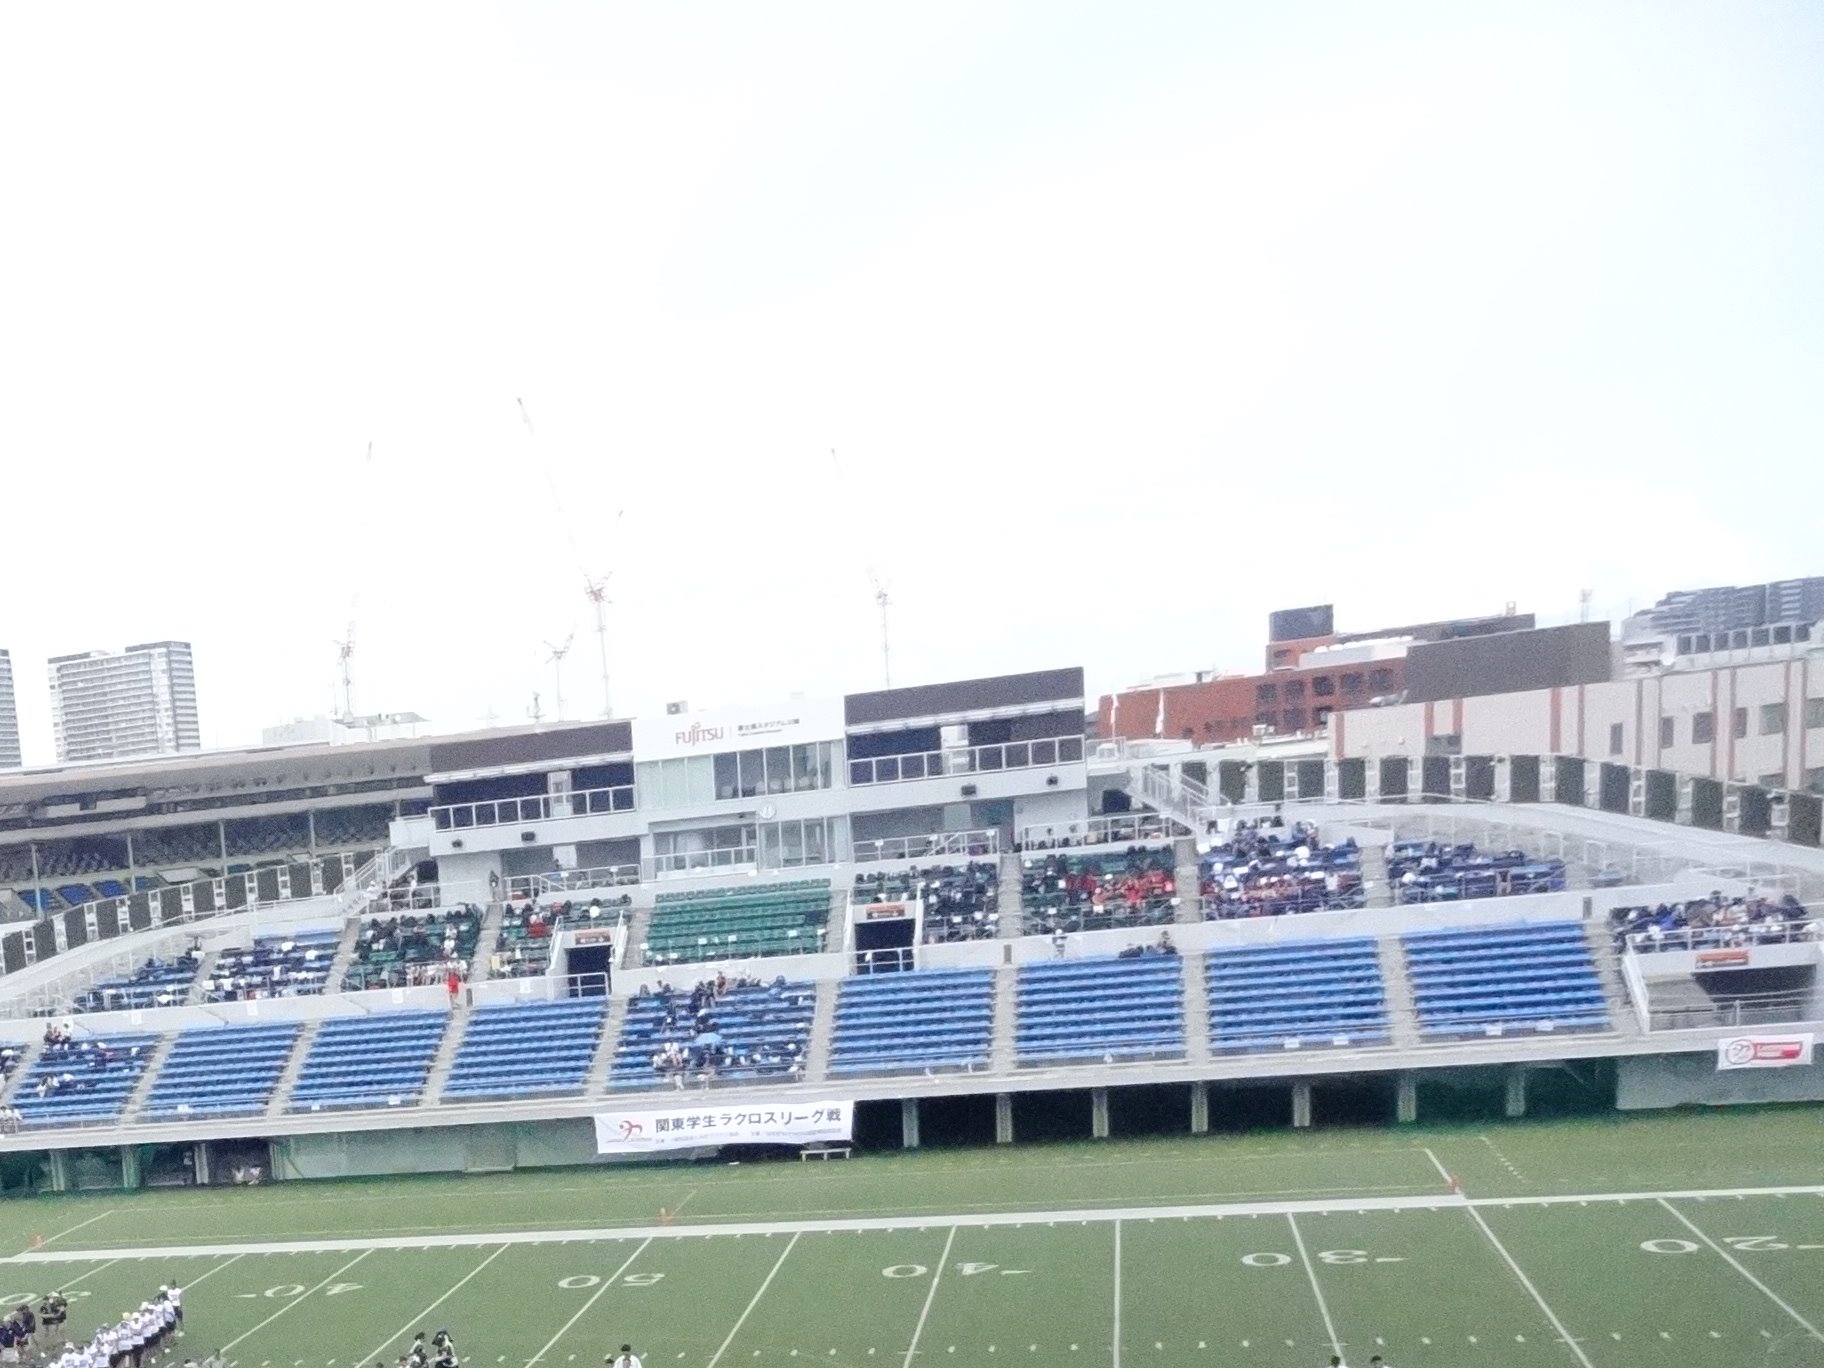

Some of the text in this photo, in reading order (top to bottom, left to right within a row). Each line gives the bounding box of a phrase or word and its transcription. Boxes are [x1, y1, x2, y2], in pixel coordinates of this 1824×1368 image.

[675, 721, 724, 746] FUJITSU
[655, 1107, 842, 1133] 関東学生ラクロスリーグ戦
